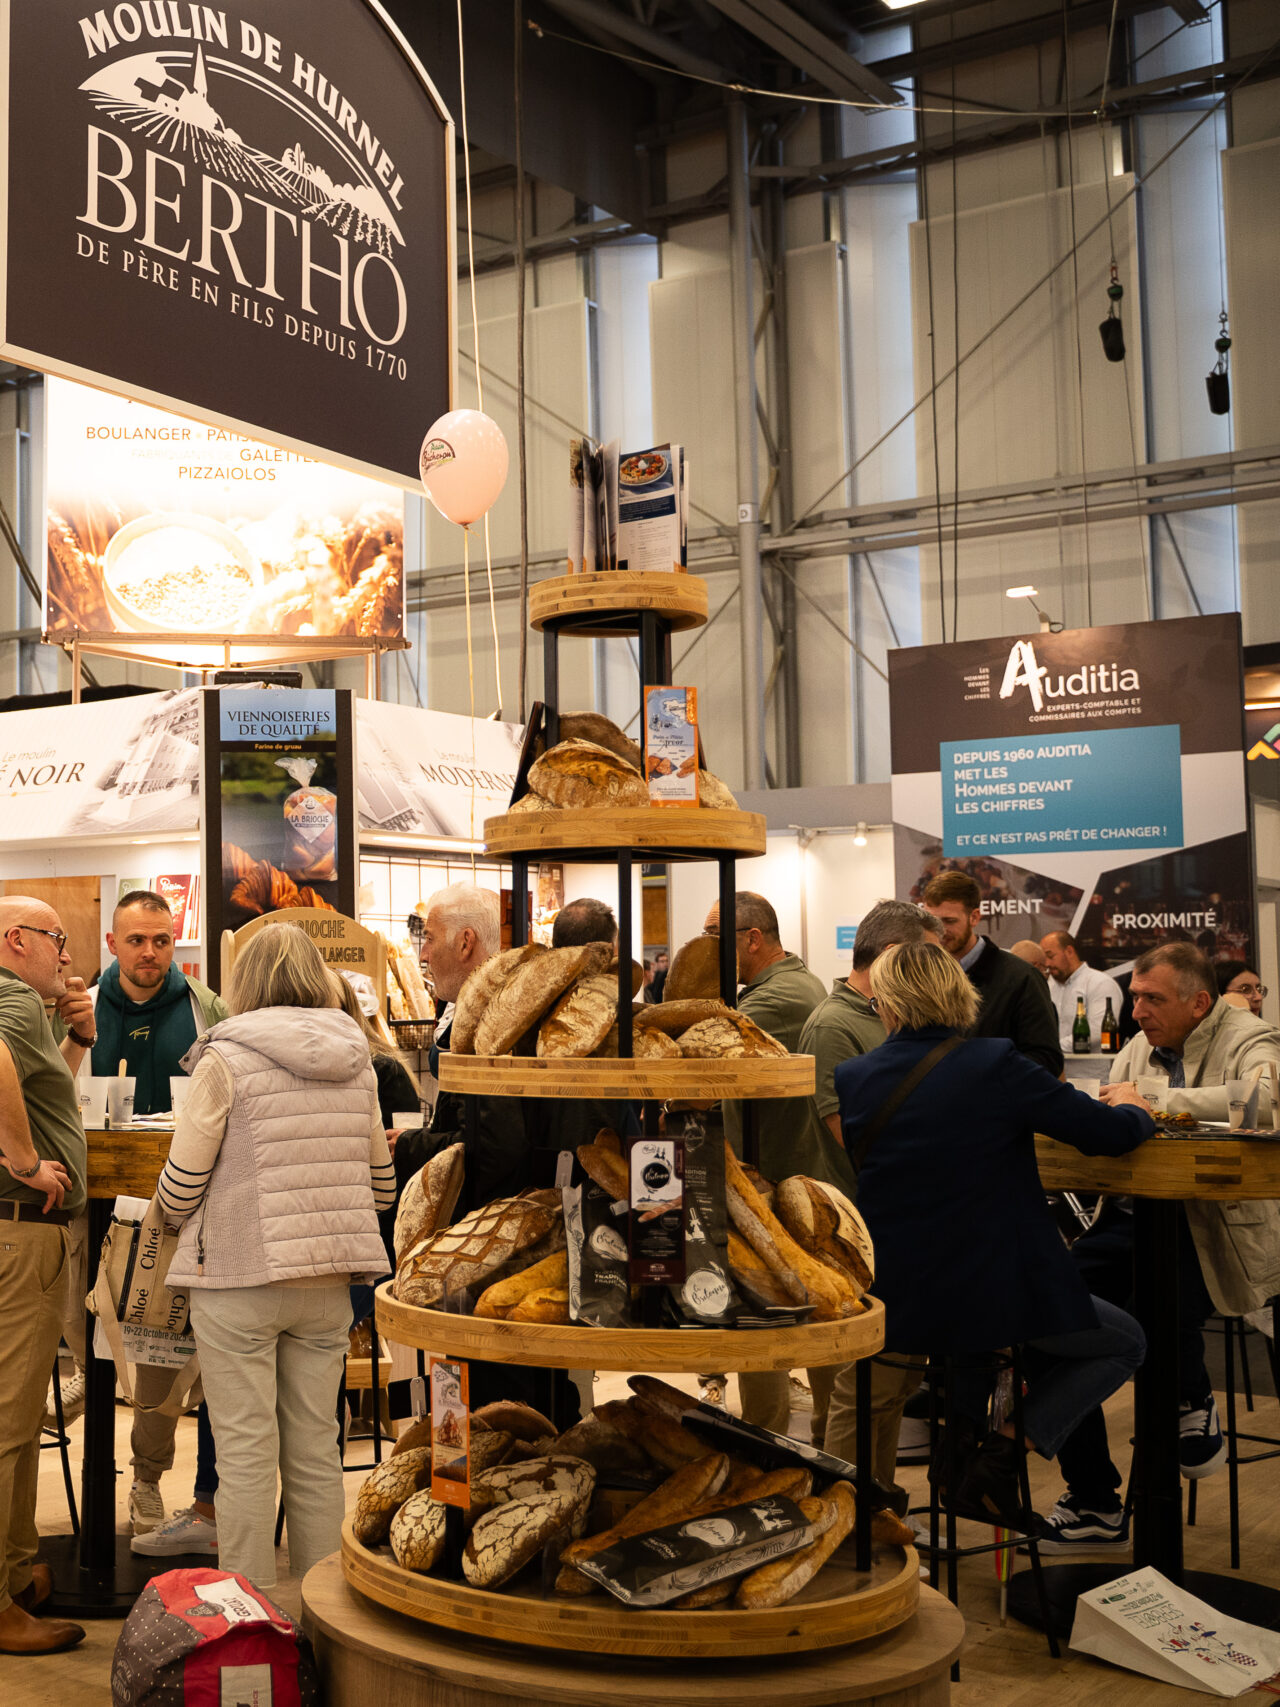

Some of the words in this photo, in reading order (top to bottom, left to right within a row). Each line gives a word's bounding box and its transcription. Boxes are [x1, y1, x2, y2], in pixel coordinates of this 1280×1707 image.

[78, 0, 228, 59] MOULIN
[240, 20, 283, 74] DE
[292, 57, 406, 211] HURNEL
[76, 124, 407, 346] BERTHO
[76, 232, 111, 265] DE
[122, 249, 179, 292] PÈRE
[191, 275, 219, 307] EN
[230, 292, 275, 328] FILS
[285, 313, 357, 362] DEPUIS
[366, 344, 407, 381] 1770
[86, 427, 191, 440] BOULANGER
[179, 467, 276, 481] PIZZAIOLOS
[999, 640, 1141, 712] Auditia
[1047, 699, 1129, 713] EXPERTS-COMPTABLE
[228, 711, 330, 723] VIENNOISERIES
[1028, 711, 1086, 723] COMMISSAIRES
[1087, 710, 1103, 718] AUX
[1104, 707, 1142, 717] COMPTES
[239, 724, 257, 735] DE
[261, 722, 320, 737] QUALITÉ
[953, 750, 1001, 765] DEPUIS
[1003, 749, 1034, 763] 1960
[1037, 744, 1092, 758] AUDITIA
[9, 762, 85, 788] NOIR
[954, 768, 981, 781] MET
[983, 766, 1008, 780] LES
[1018, 779, 1073, 794] DEVANT
[955, 801, 979, 814] LES
[981, 798, 1045, 813] CHIFFRES
[301, 815, 329, 823] BRIOCHE
[956, 835, 971, 846] ET
[972, 834, 988, 845] CE
[990, 832, 1022, 845] N'EST
[1025, 831, 1047, 843] PAS
[1049, 828, 1078, 842] PRÊT
[1082, 829, 1098, 840] DE
[1100, 826, 1160, 839] CHANGER
[1112, 907, 1216, 929] PROXIMITÉ
[140, 1228, 160, 1270] Chloé
[127, 1288, 149, 1324] Chloé
[143, 1327, 169, 1339] Octobre
